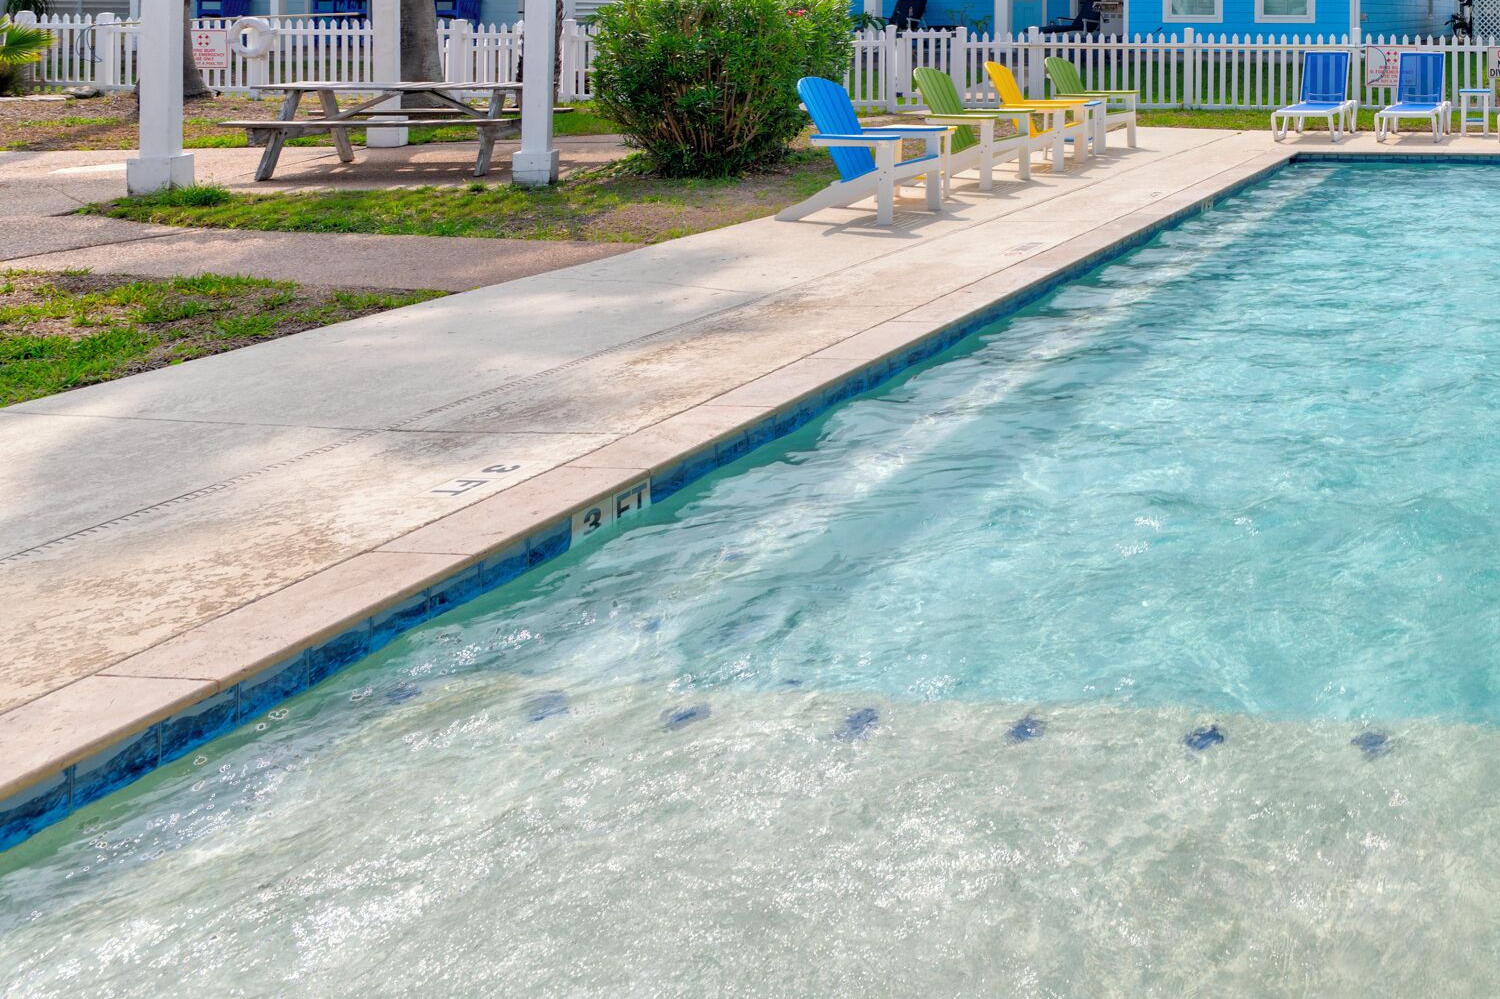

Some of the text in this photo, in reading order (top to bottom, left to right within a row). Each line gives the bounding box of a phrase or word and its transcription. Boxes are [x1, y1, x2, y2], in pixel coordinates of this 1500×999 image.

[431, 464, 521, 496] 3 FT
[583, 482, 647, 536] 3 FT
